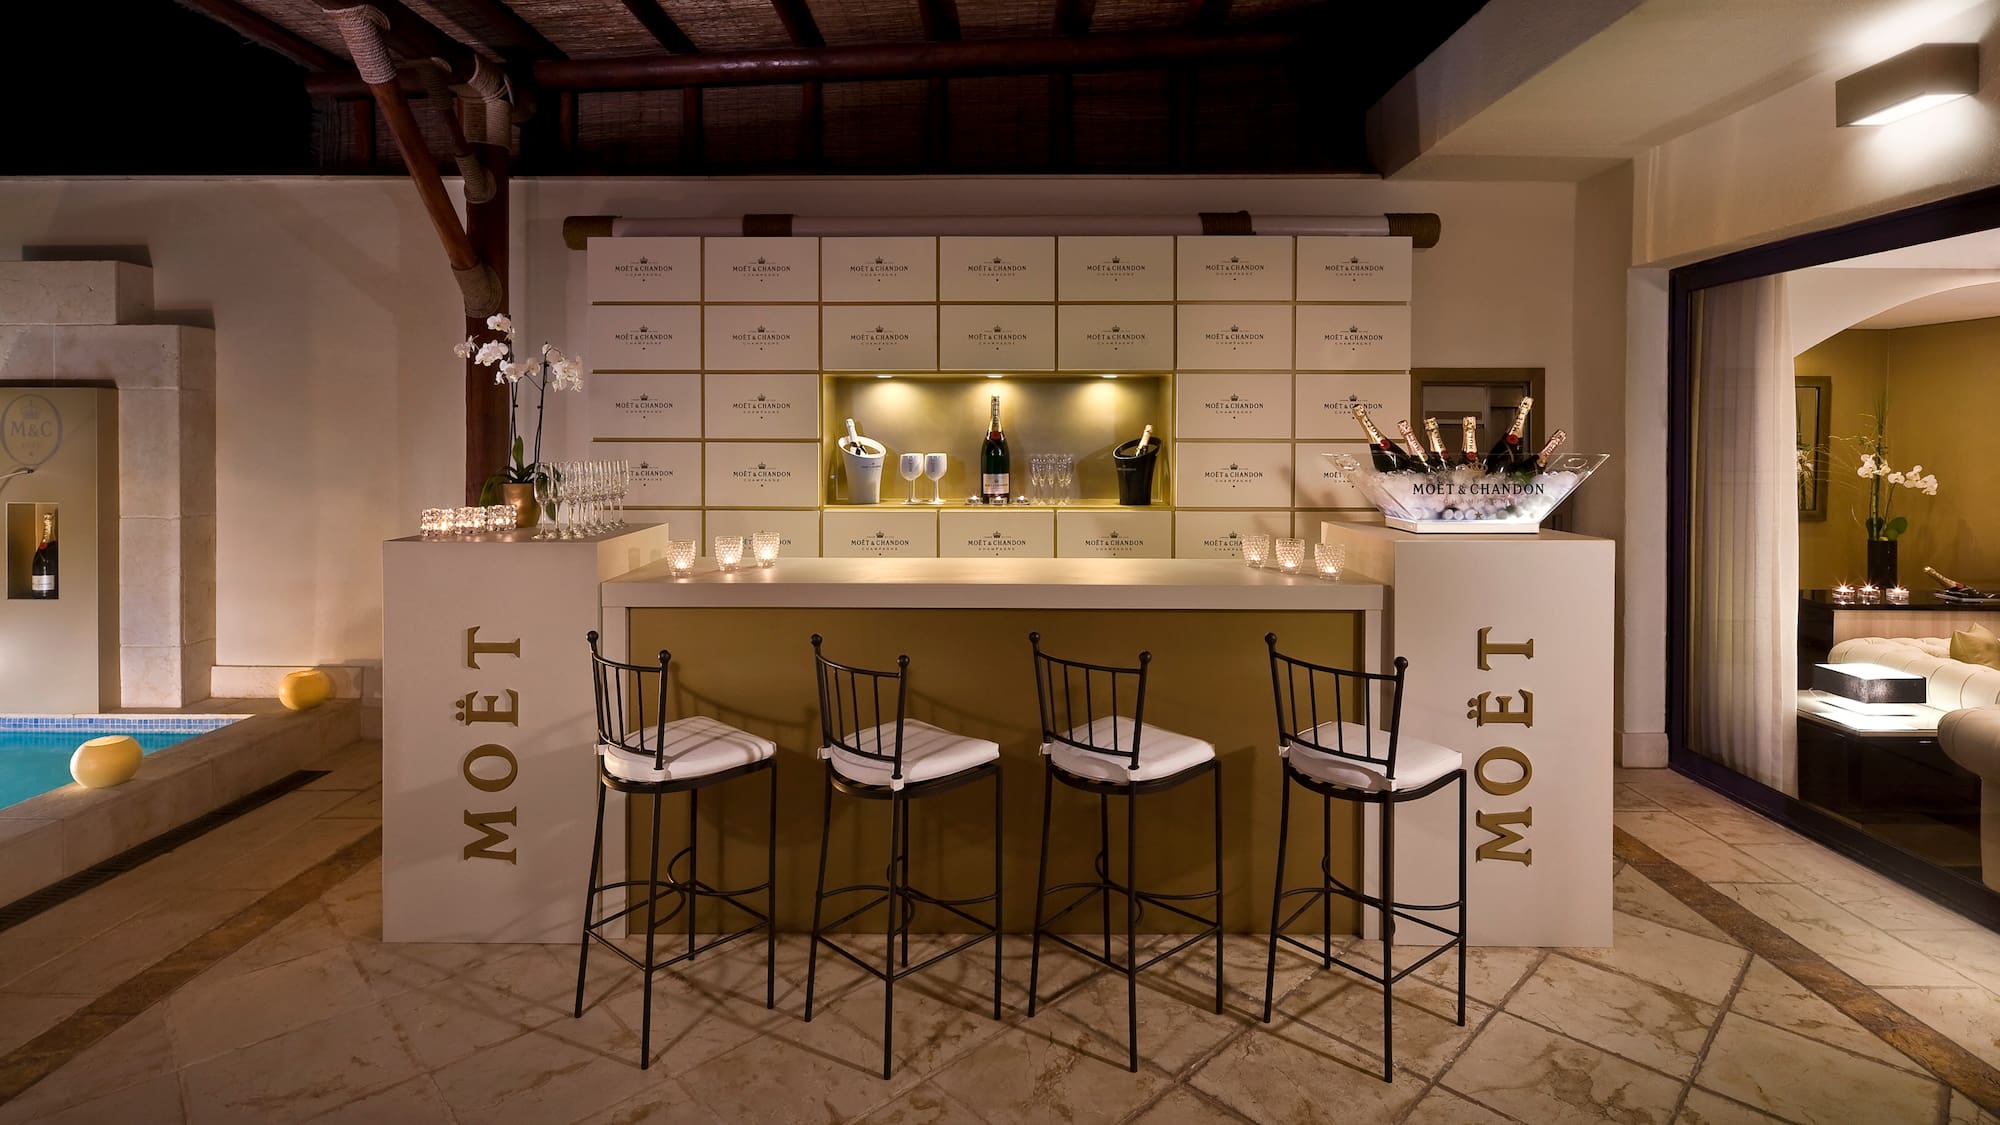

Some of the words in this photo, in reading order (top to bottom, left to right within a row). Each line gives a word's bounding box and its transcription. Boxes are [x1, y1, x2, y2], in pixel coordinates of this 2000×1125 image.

[1458, 484, 1466, 495] &
[1470, 483, 1544, 495] CHANDON
[456, 625, 520, 865] MOËT
[1467, 626, 1534, 867] MOËT
